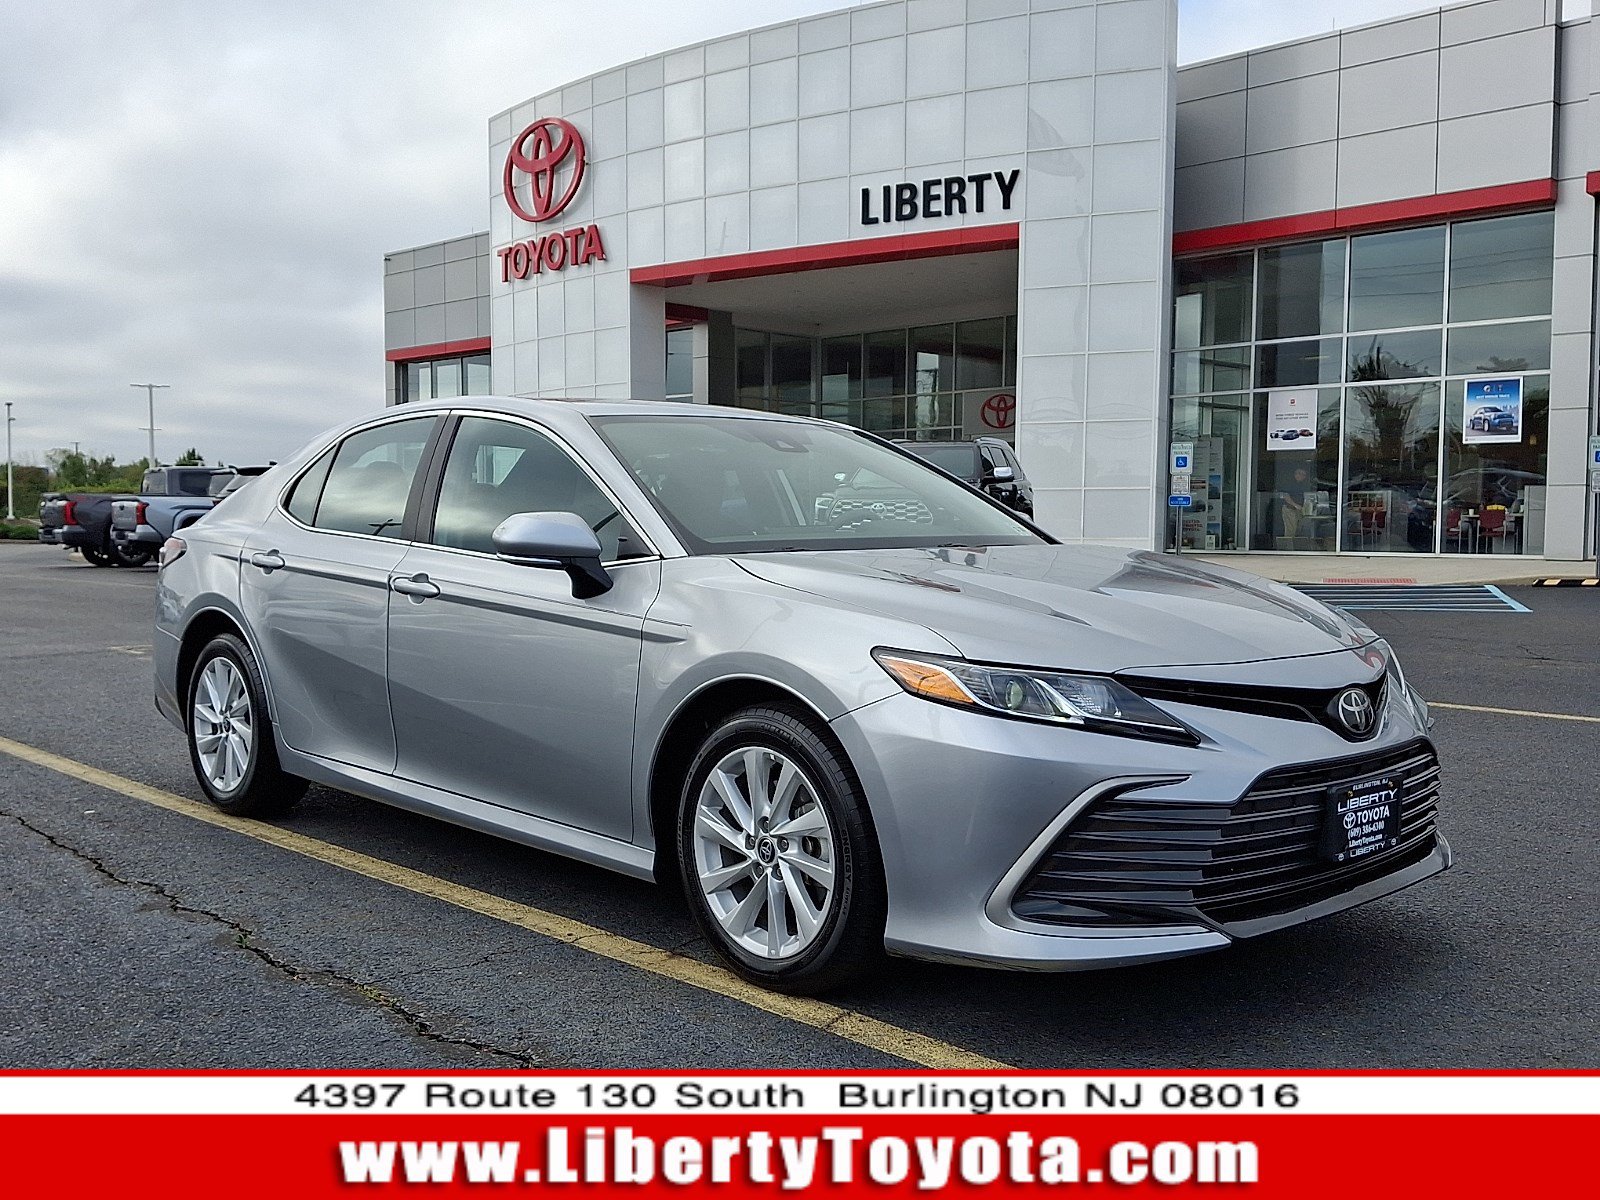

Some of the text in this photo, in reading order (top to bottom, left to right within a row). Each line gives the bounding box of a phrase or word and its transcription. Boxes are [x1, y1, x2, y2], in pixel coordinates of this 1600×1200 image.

[861, 169, 1020, 225] LIBERTY
[497, 223, 607, 283] TOYOTA
[1338, 788, 1398, 812] LIBERTY
[1357, 805, 1390, 825] TOYOTA
[1350, 841, 1385, 857] LIBERTY
